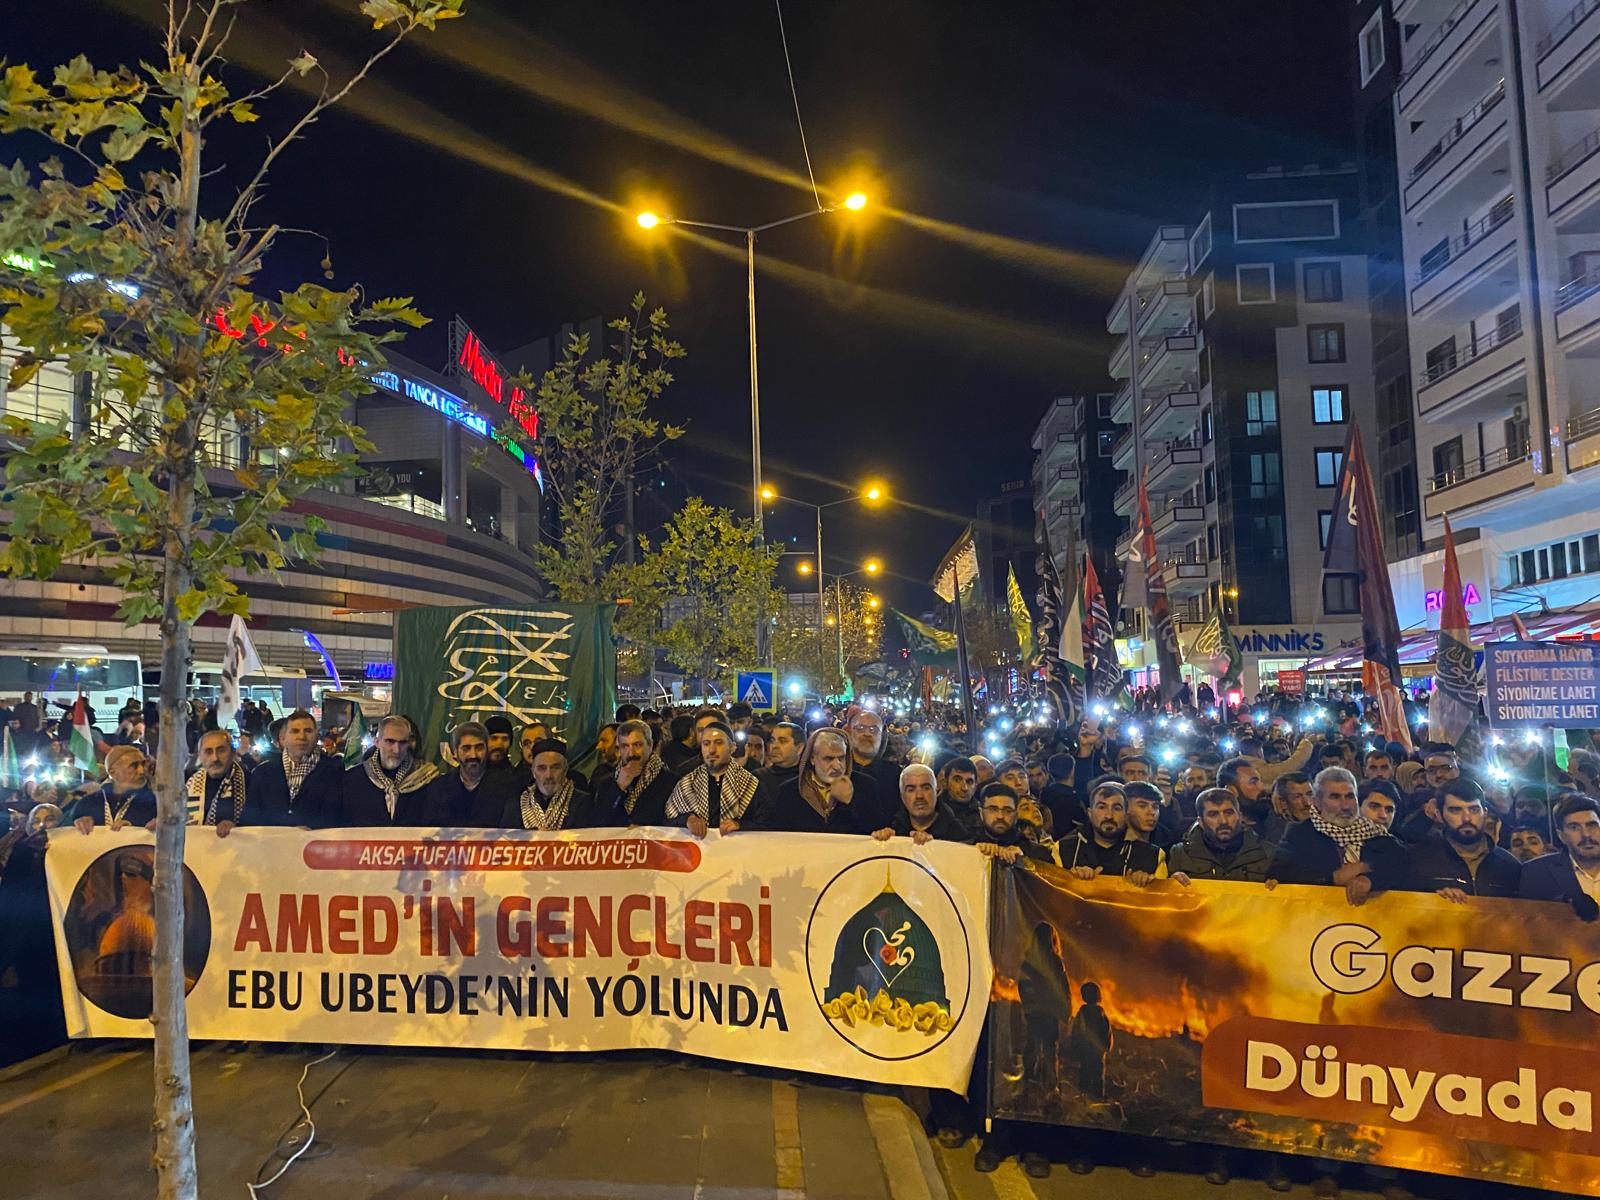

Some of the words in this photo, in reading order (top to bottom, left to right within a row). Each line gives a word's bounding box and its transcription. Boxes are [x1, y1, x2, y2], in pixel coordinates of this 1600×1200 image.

[403, 378, 440, 410] TANCA
[1497, 685, 1559, 701] SİYONİZME
[1560, 686, 1597, 700] LANET
[1498, 704, 1560, 720] SİYONİZME
[1561, 704, 1599, 719] LANET
[358, 845, 406, 866] AKSA
[411, 845, 476, 866] TUFANI
[478, 845, 548, 866] DESTEK
[552, 842, 648, 869] YÜRÜYÜŞÜ
[496, 885, 773, 971] GENÇLERİ
[227, 969, 303, 1011] EBU
[586, 973, 790, 1033] YOLUNDA
[1245, 1039, 1593, 1133] Dünyada
